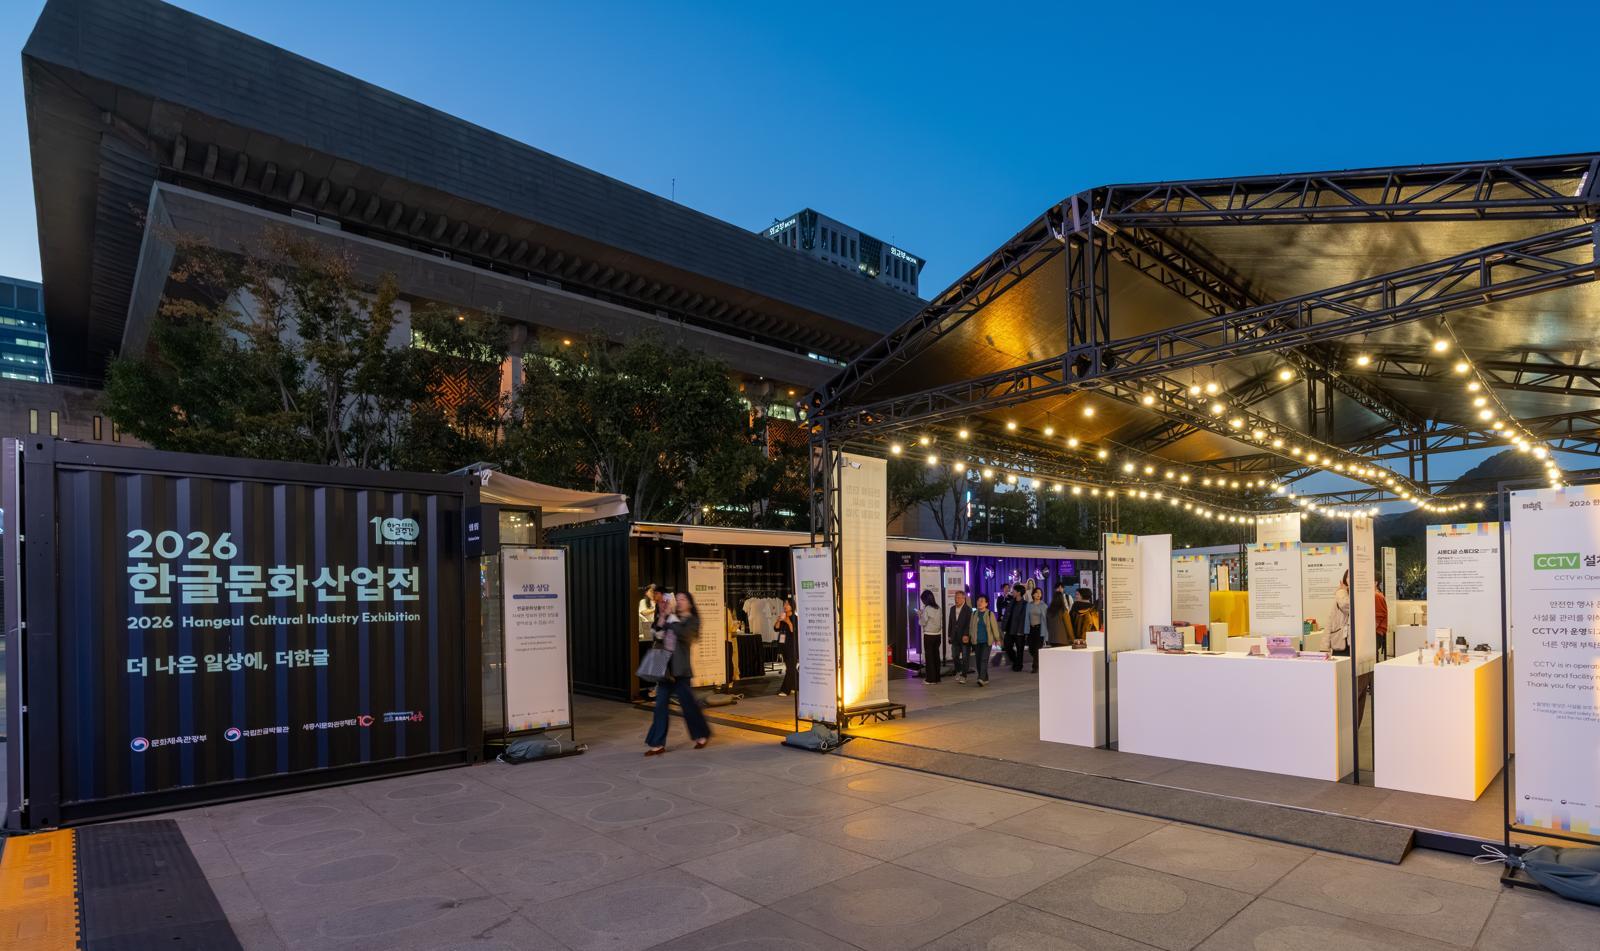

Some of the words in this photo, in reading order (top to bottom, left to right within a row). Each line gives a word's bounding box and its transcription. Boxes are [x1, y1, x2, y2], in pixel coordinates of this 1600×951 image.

[770, 221, 784, 236] 외교부
[890, 246, 906, 259] 외교부
[126, 529, 238, 560] 2026
[1536, 555, 1578, 568] CCTV
[126, 562, 420, 604] 한글문화산업전
[127, 616, 174, 630] 2026
[182, 616, 244, 628] Hangeul
[250, 614, 304, 626] Cultural
[307, 613, 359, 625] Industry
[362, 612, 420, 623] Exhibition
[1532, 627, 1568, 635] CCTV가
[1542, 640, 1558, 648] 너른
[1560, 640, 1578, 648] 양해
[126, 656, 148, 676] 더
[155, 655, 198, 675] 나은
[204, 651, 268, 672] 일상에,
[275, 648, 330, 668] 더한글
[1570, 673, 1594, 681] facility
[242, 726, 290, 737] 국립한글박물관
[151, 734, 208, 748] 문화체육관광부
